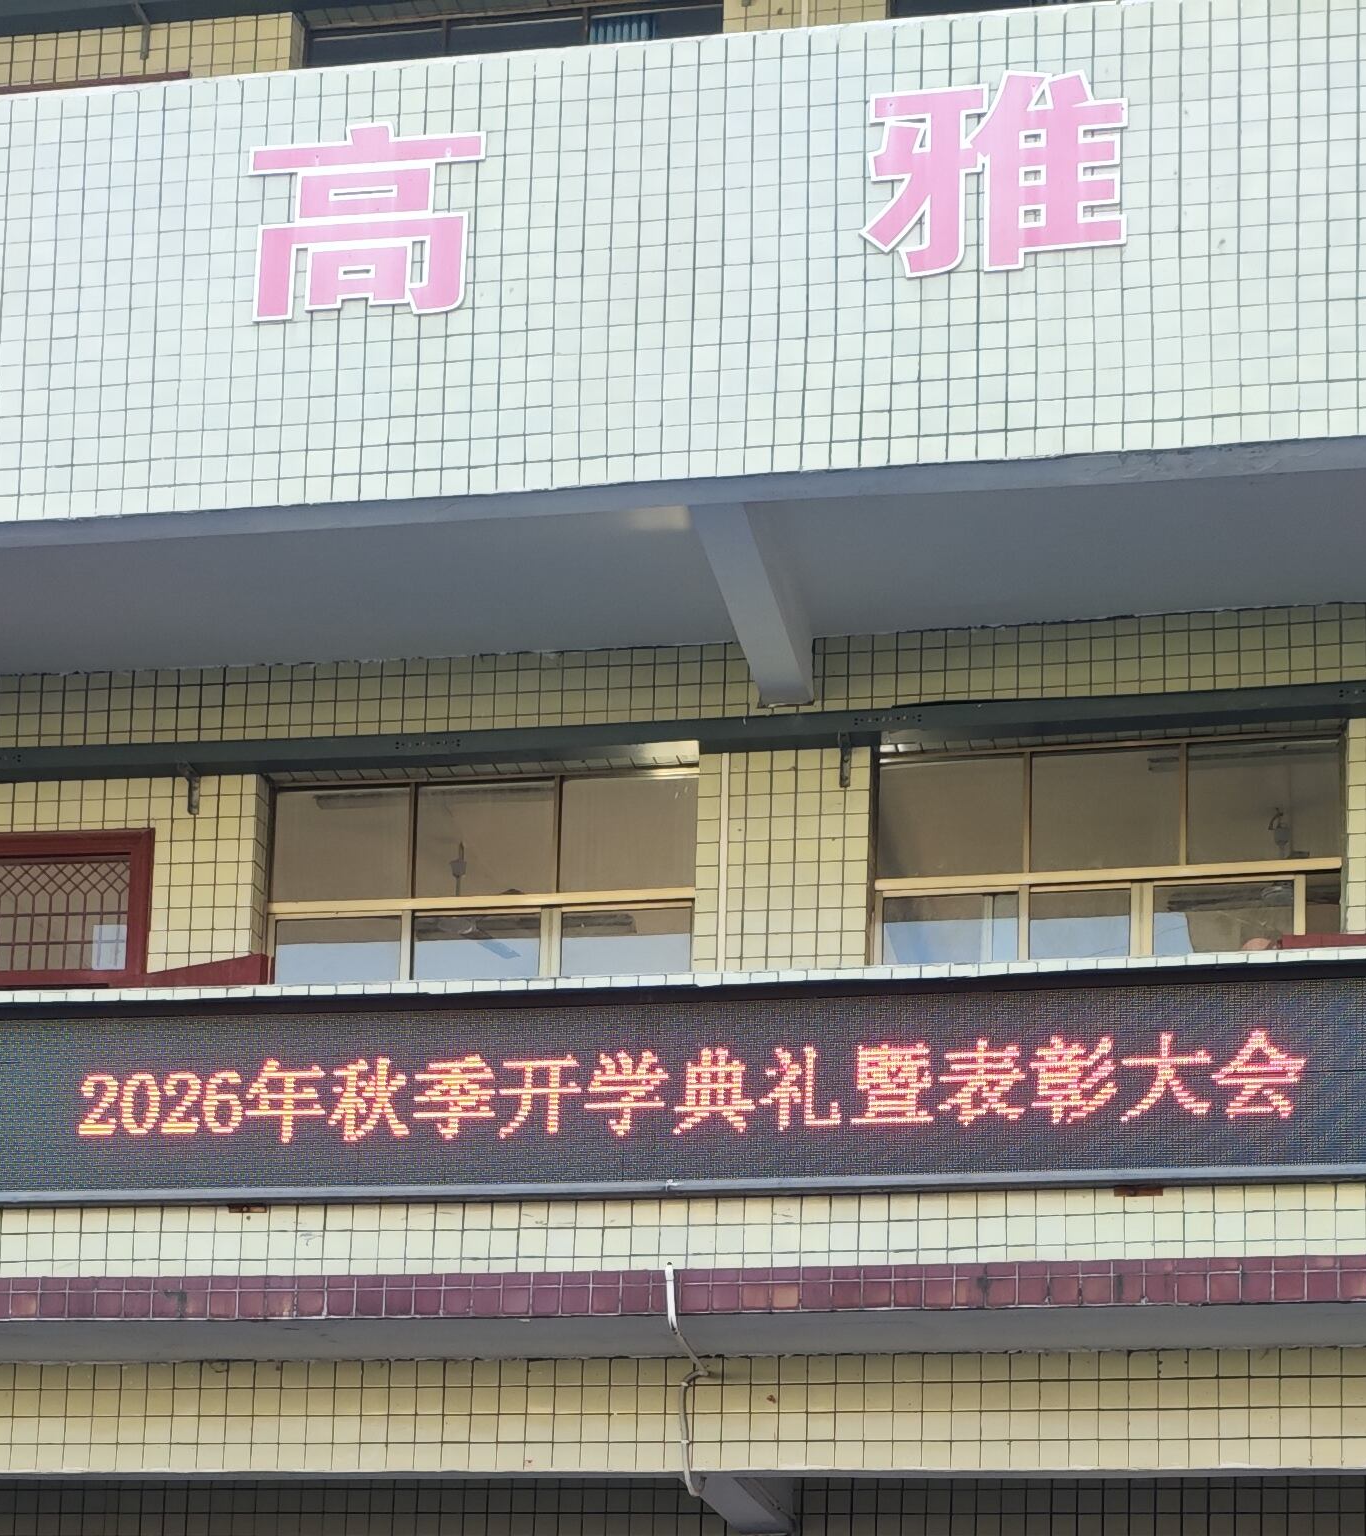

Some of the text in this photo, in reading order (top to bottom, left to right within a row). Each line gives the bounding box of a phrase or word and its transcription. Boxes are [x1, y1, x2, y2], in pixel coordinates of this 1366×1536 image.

[248, 69, 1129, 324] 高雅
[78, 1029, 1307, 1144] 2026年秋季开学典礼暨表彰大会
